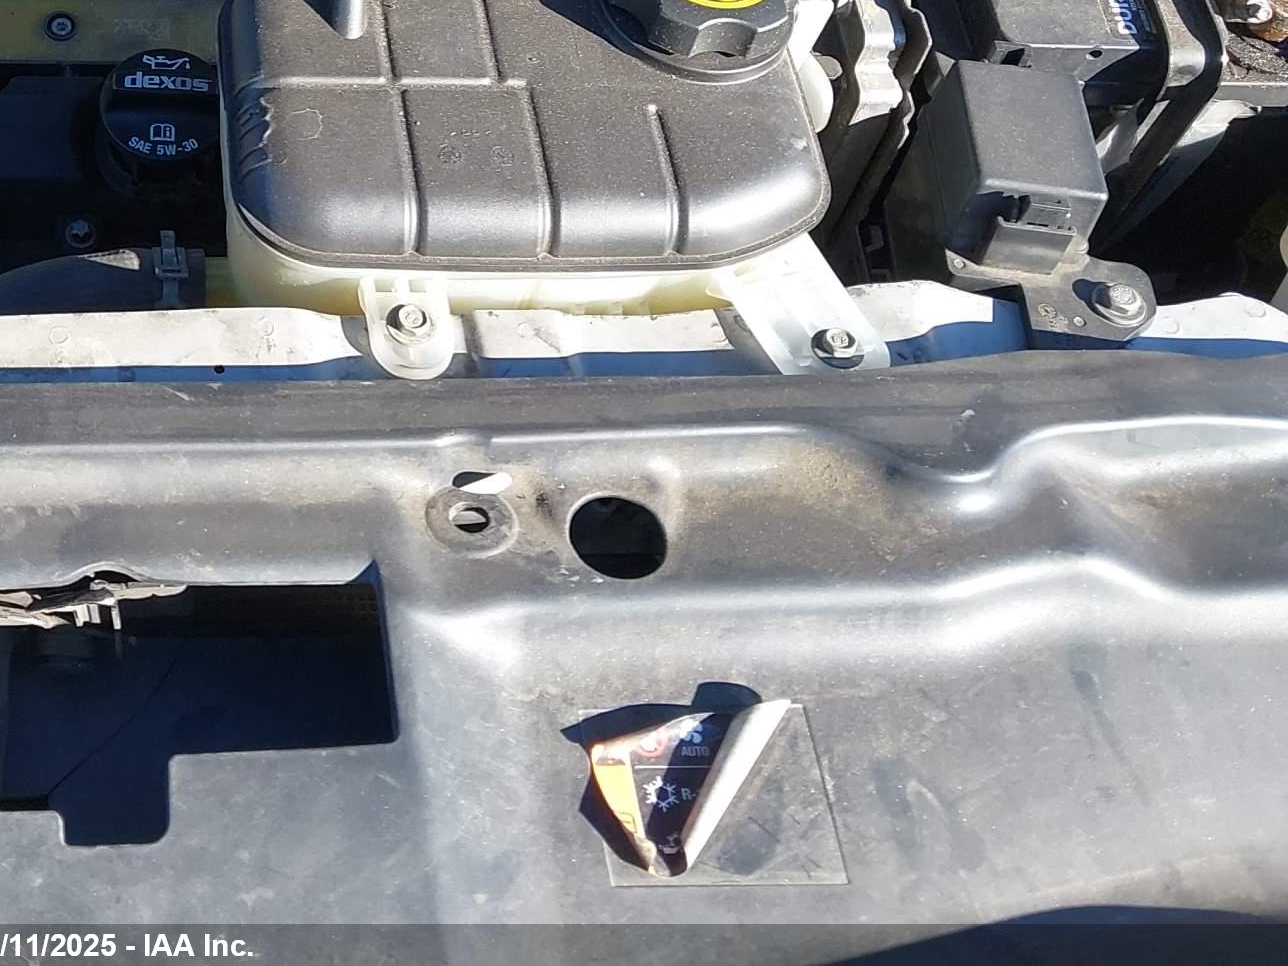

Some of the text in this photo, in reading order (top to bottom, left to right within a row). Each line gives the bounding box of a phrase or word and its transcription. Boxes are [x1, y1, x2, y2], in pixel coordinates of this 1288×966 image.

[124, 71, 213, 92] dexos
[128, 136, 199, 156] SAE 5W-30
[681, 746, 710, 757] AUTO
